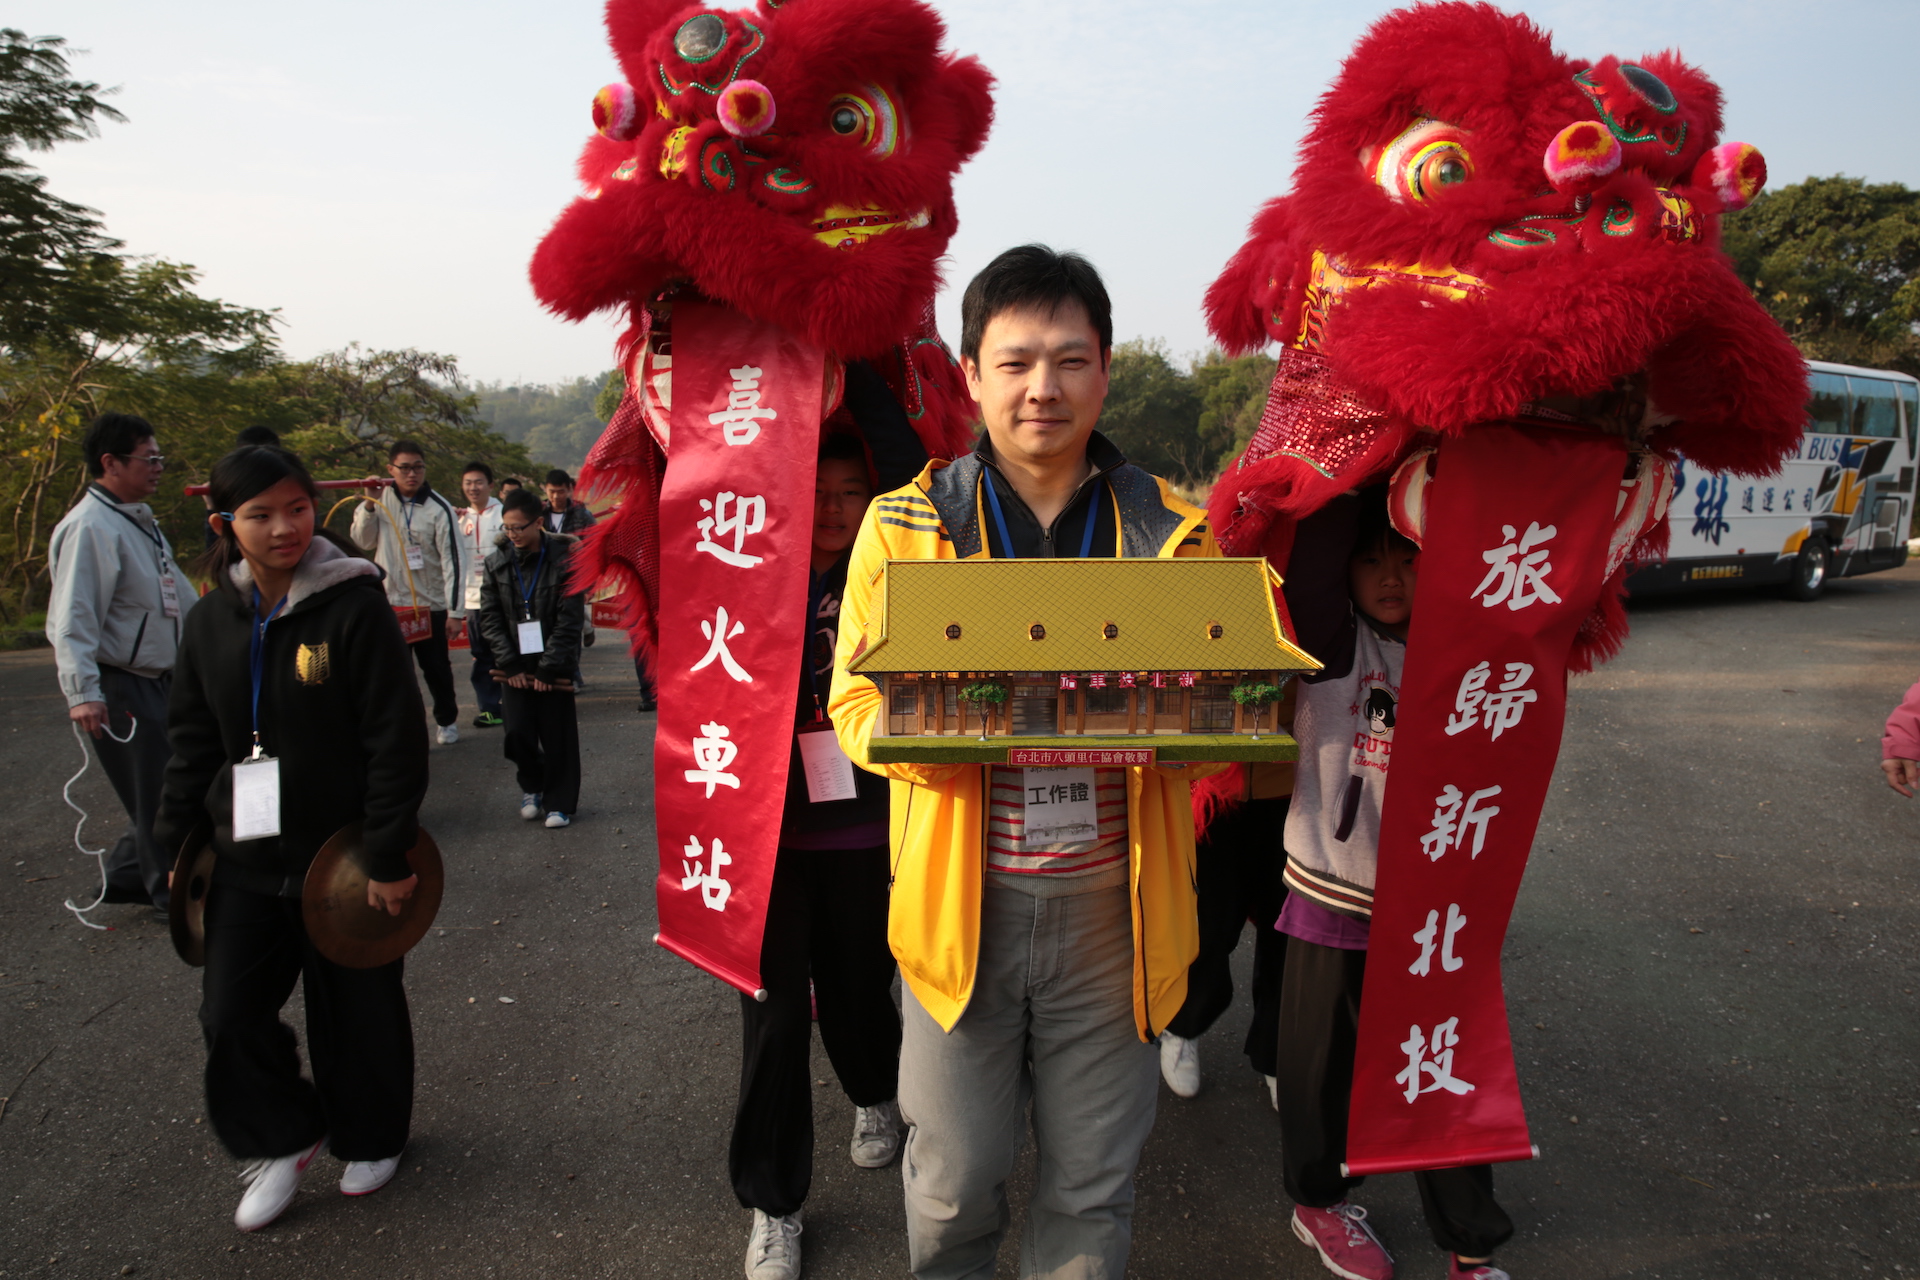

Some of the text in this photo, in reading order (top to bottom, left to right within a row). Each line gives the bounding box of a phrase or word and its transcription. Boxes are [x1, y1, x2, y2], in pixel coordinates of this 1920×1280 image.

[1808, 437, 1841, 460] BUS
[681, 364, 777, 912] 喜迎火車站
[1016, 751, 1148, 763] 台北市八頭里仁協會敬製
[1028, 782, 1089, 805] 工作證
[1395, 520, 1562, 1105] 旅歸新北投
